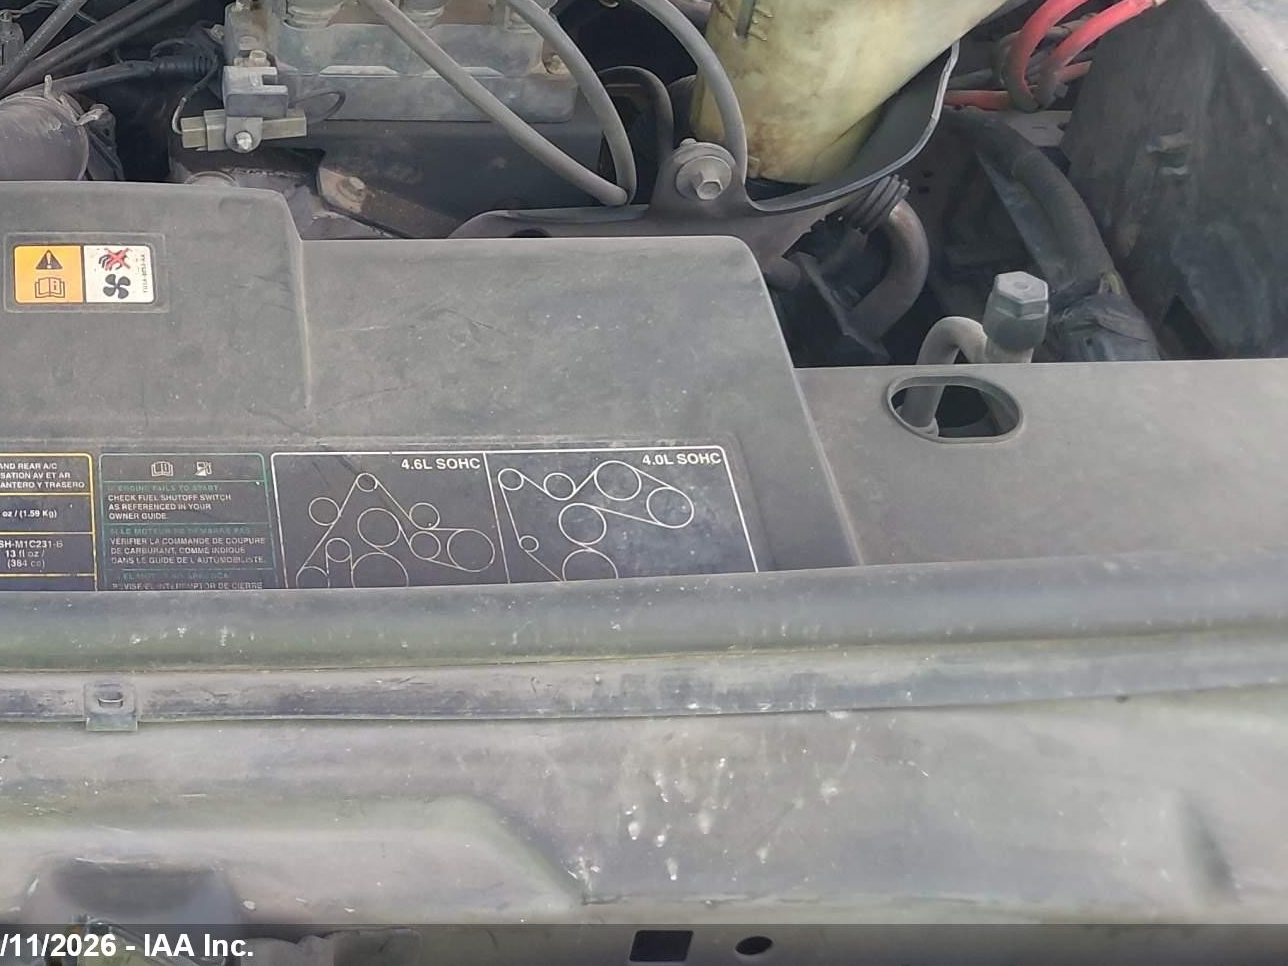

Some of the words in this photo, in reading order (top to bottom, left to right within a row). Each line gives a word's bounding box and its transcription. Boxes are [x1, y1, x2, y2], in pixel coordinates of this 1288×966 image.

[642, 454, 675, 466] 4.0L
[678, 452, 722, 466] SOHC
[401, 458, 434, 470] 4.6L
[437, 458, 481, 470] SOHC
[44, 481, 85, 489] TRASERO
[108, 494, 136, 502] CHECK
[122, 503, 177, 511] REFERENCED
[178, 503, 186, 511] IN
[188, 503, 212, 511] YOUR
[19, 509, 40, 518] (1.59
[42, 509, 58, 518] Kg)
[149, 556, 174, 564] GUIDE
[176, 556, 188, 564] DE
